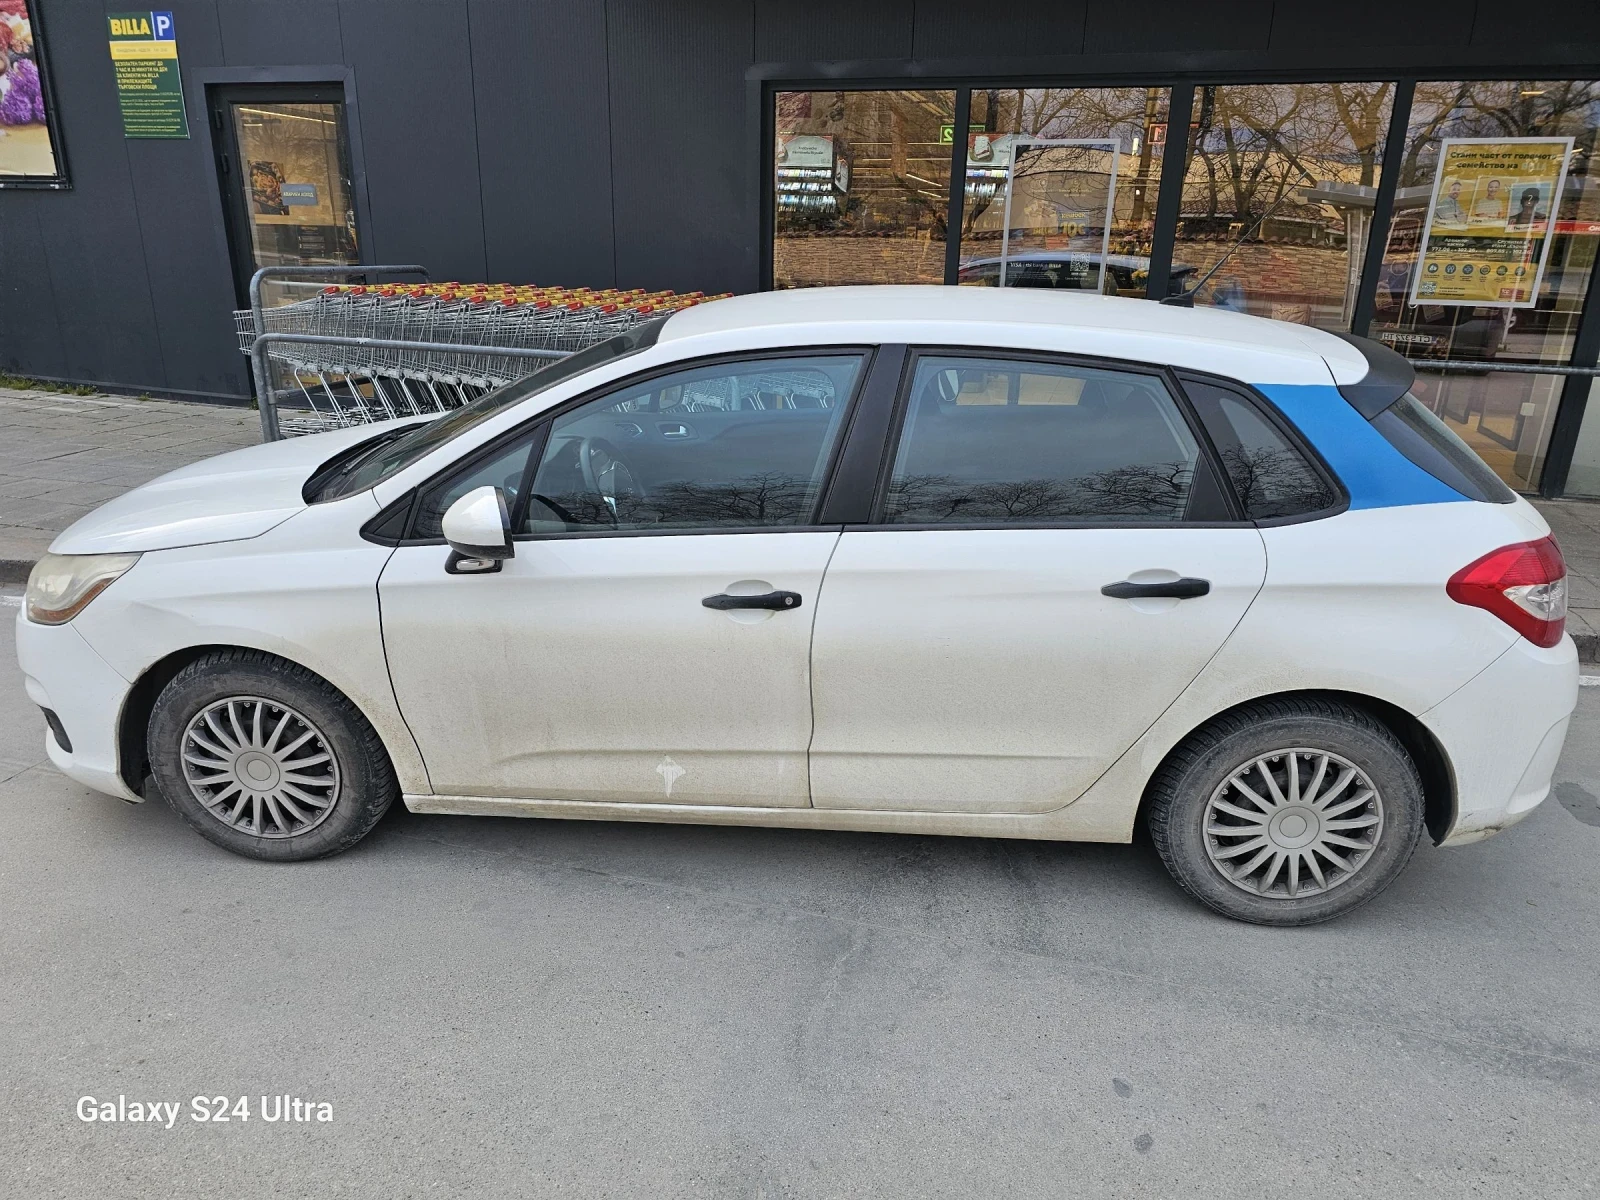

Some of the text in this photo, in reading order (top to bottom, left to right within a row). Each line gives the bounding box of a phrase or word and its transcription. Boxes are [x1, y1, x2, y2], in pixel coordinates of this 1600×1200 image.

[110, 18, 151, 35] BILLA
[156, 15, 170, 36] P
[1456, 161, 1505, 169] семейство
